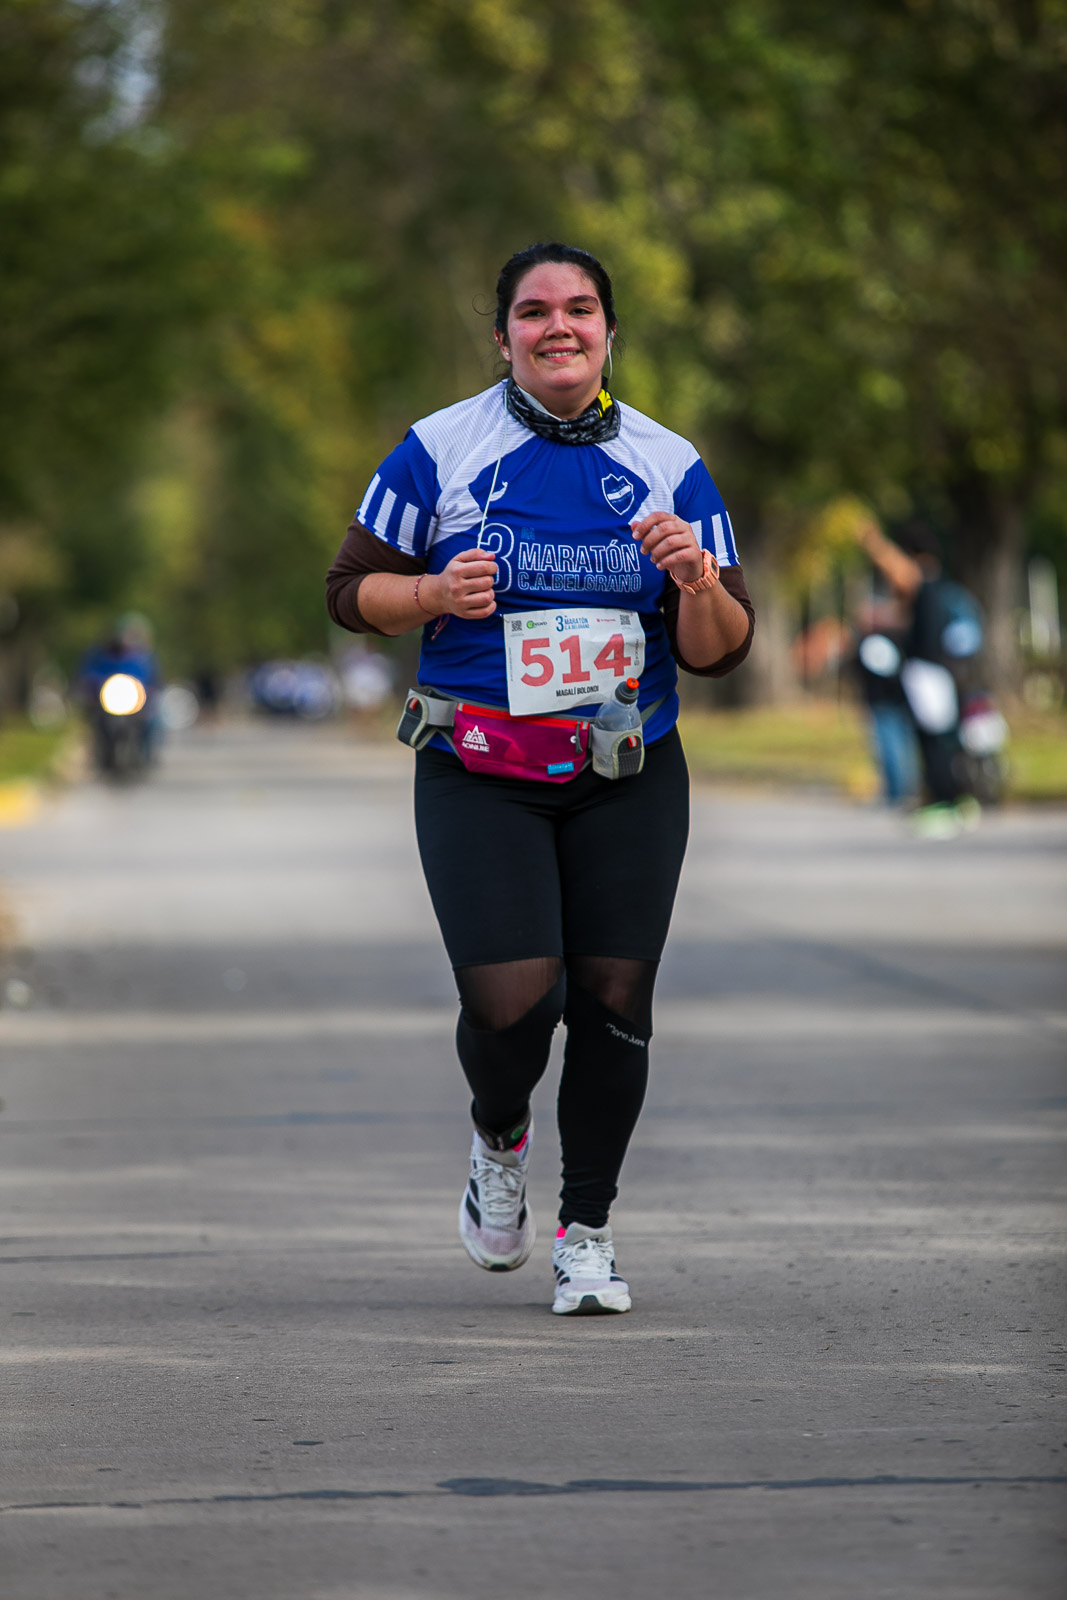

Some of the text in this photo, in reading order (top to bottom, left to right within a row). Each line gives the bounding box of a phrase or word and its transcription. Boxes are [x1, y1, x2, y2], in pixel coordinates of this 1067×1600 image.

[478, 522, 515, 593] 3
[518, 539, 641, 573] MARATÓN
[555, 615, 564, 632] 3
[521, 633, 632, 687] 514
